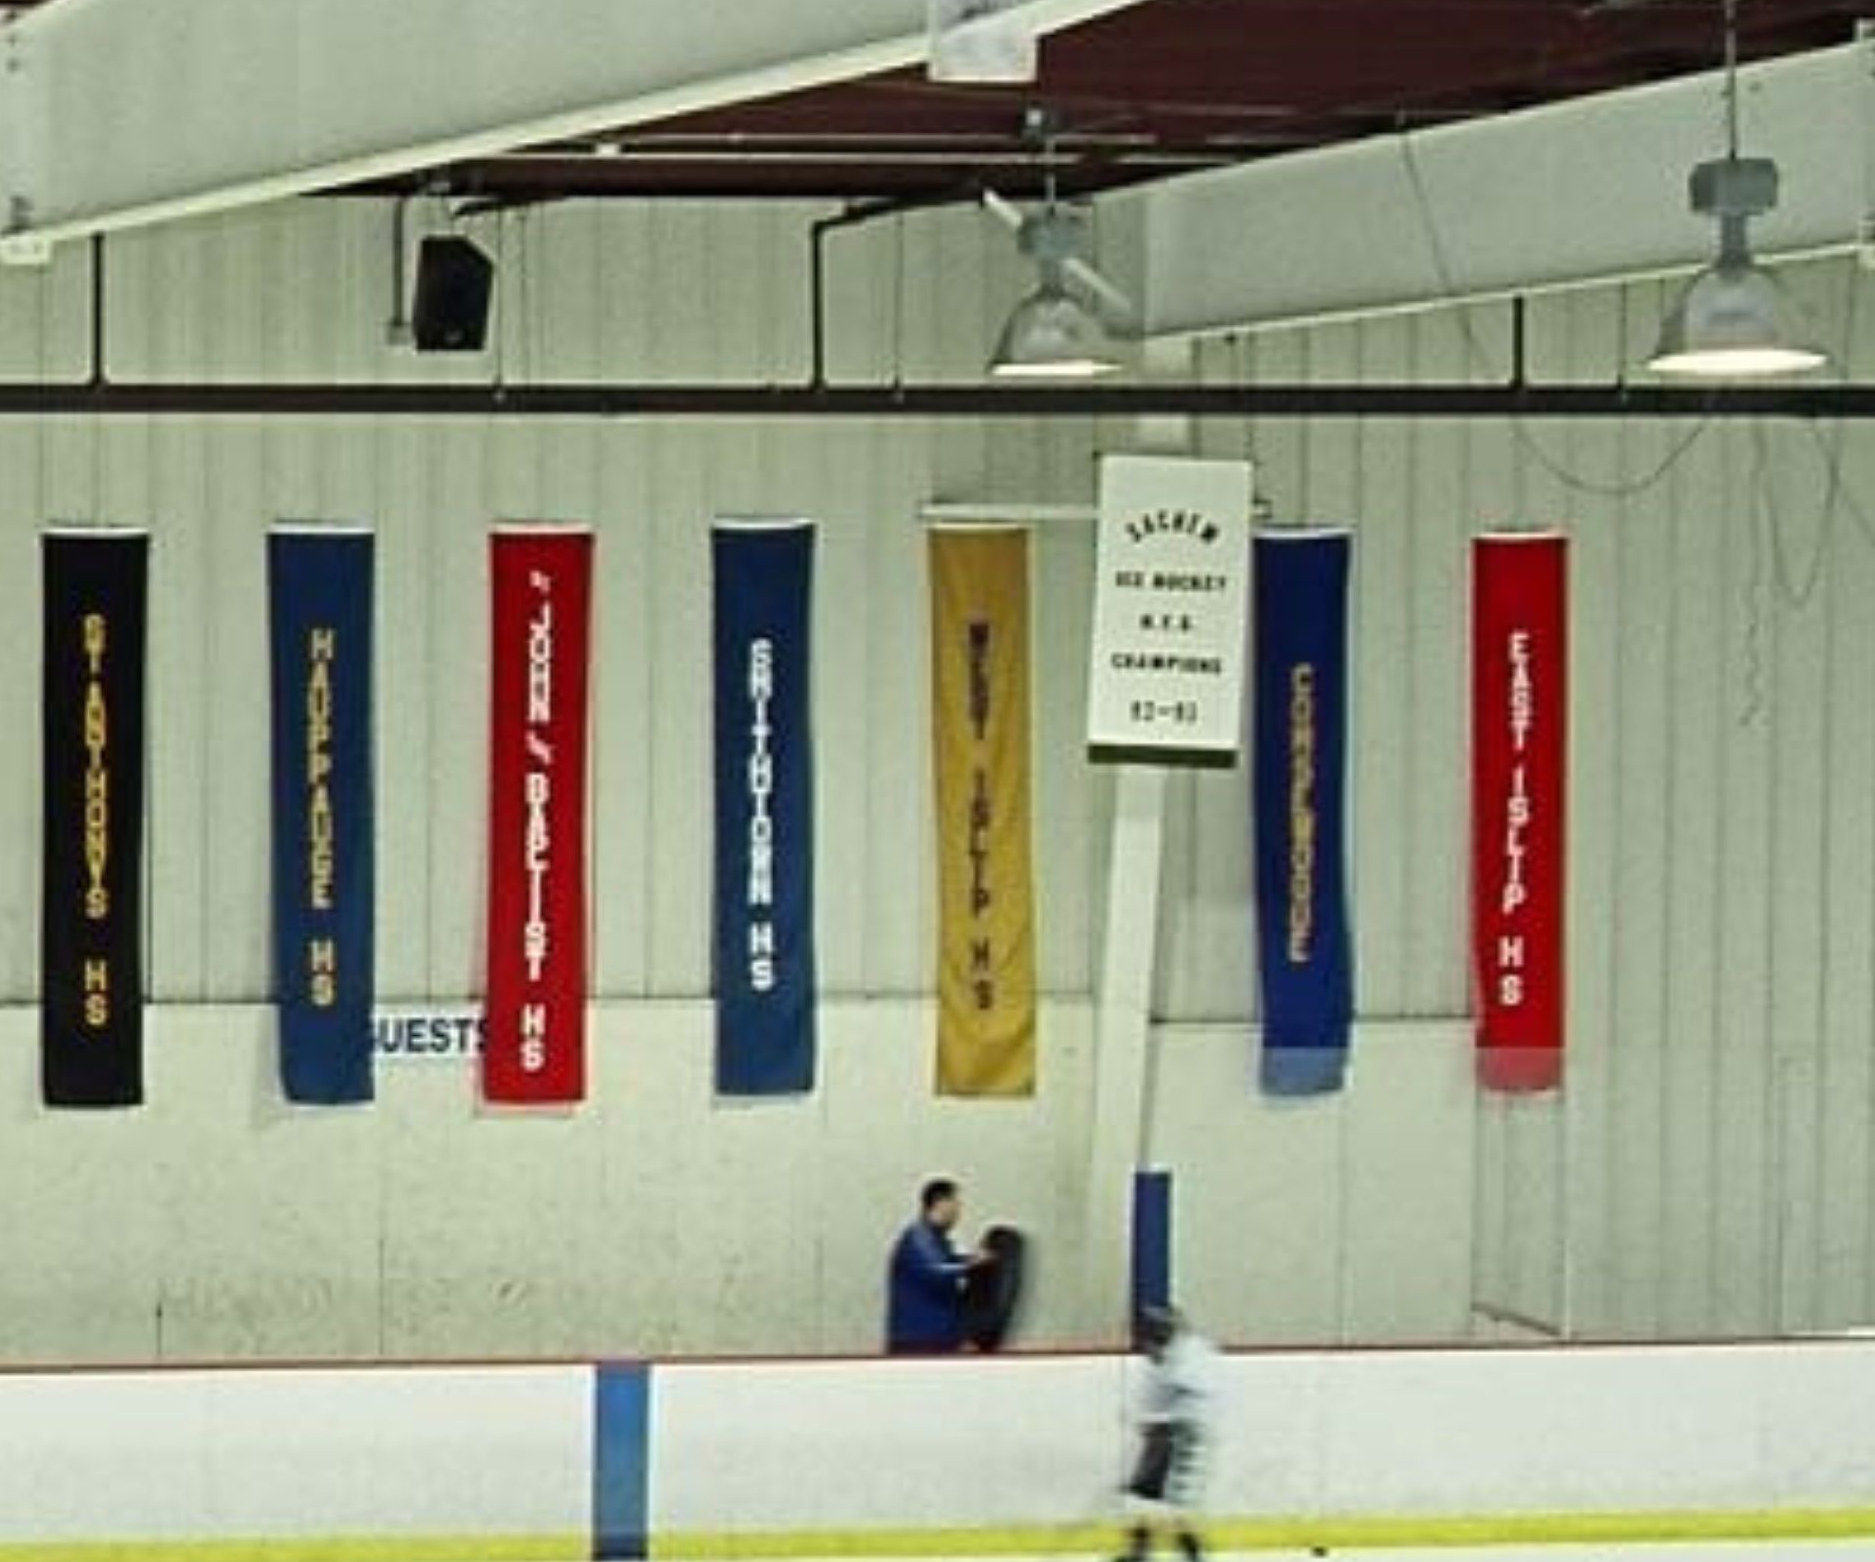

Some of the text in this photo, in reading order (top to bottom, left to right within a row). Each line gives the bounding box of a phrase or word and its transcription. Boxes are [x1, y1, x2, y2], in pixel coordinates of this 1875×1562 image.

[1126, 510, 1220, 544] SACHEM
[1152, 573, 1226, 591] HOCKEY
[528, 601, 552, 724] JOHN
[1111, 652, 1222, 676] CHAMPIONS
[307, 627, 336, 1007] HAUPPAUGE HS
[749, 638, 775, 991] SMITHTOWN HS
[968, 623, 993, 1010] WEST ISLIP HS
[1497, 632, 1533, 1005] EAST ISLIP HS
[525, 772, 550, 982] BAPTIST
[84, 959, 109, 1026] HS
[372, 1017, 489, 1054] UESTS
[520, 1004, 546, 1072] HS
